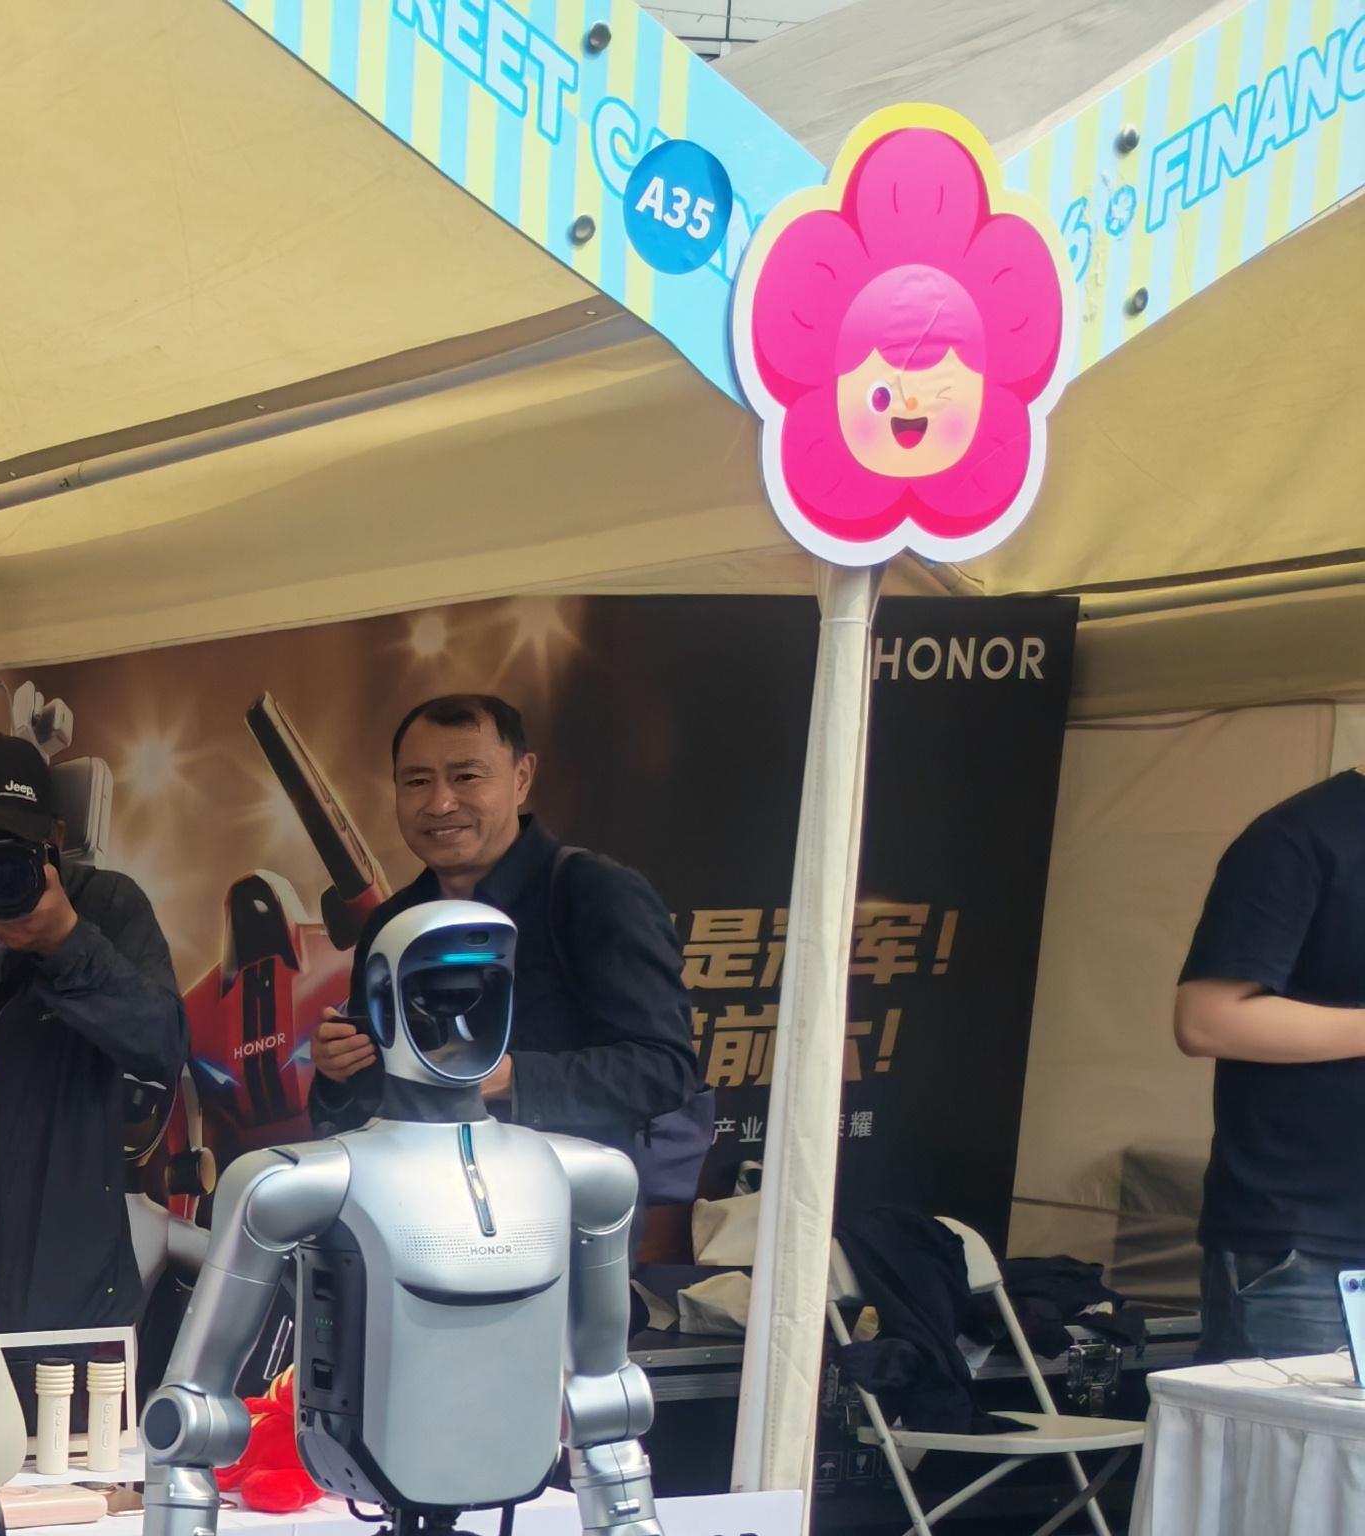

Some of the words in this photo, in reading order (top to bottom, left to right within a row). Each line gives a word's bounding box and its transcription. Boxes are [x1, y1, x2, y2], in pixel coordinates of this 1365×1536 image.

[634, 176, 716, 240] A35
[873, 636, 1047, 681] HONOR
[5, 780, 34, 796] Jeep
[233, 1032, 286, 1060] HONOR
[470, 1245, 513, 1256] HONOR
